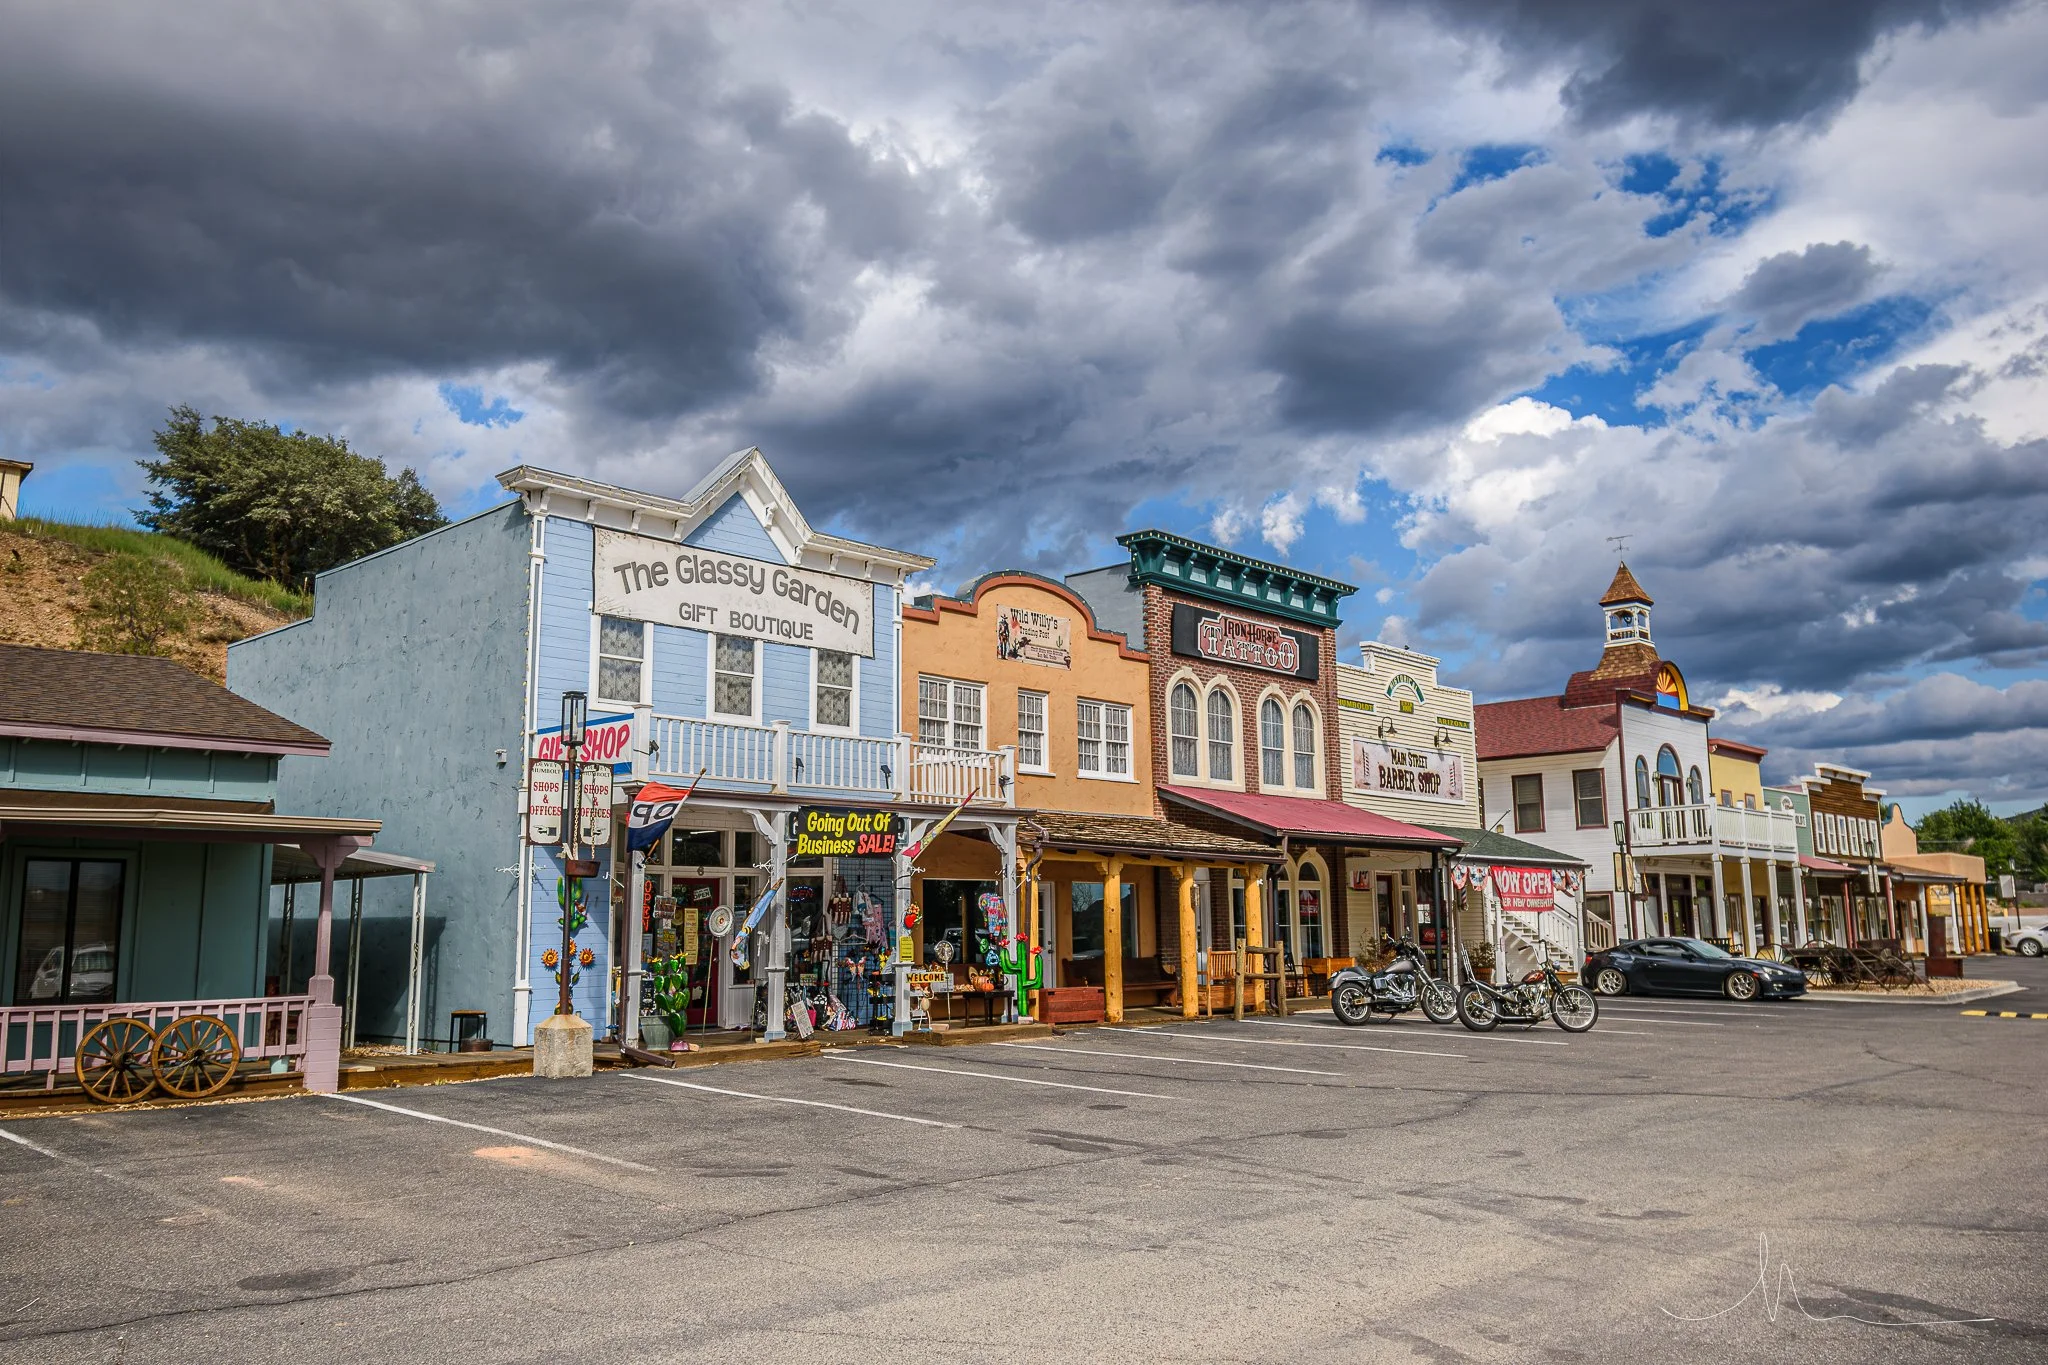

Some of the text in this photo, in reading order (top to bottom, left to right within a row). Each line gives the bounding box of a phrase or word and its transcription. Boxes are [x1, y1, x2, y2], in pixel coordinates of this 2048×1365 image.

[613, 554, 860, 634] The Glassy Garden
[678, 602, 814, 640] GIFT BOUTIQUE
[1010, 608, 1058, 630] Wild Willy's
[1223, 618, 1279, 645] IRON HORSE
[1203, 625, 1295, 669] TATTOO
[1438, 717, 1468, 728] ARIZONA
[580, 724, 630, 762] SHOP
[586, 764, 608, 772] DEEY
[533, 781, 560, 793] SHOPS
[584, 784, 609, 795] SHOPS
[1379, 765, 1441, 795] BARBER SHOP
[542, 794, 549, 804] &
[530, 805, 562, 817] OFFICES
[580, 808, 611, 819] OFFICES
[807, 811, 845, 837] Going
[847, 813, 872, 832] Out
[873, 813, 892, 832] Of
[797, 834, 896, 855] Business SALE!
[1494, 870, 1552, 894] NOW OPEN
[643, 880, 653, 931] OPEN
[906, 973, 945, 983] WELCOME
